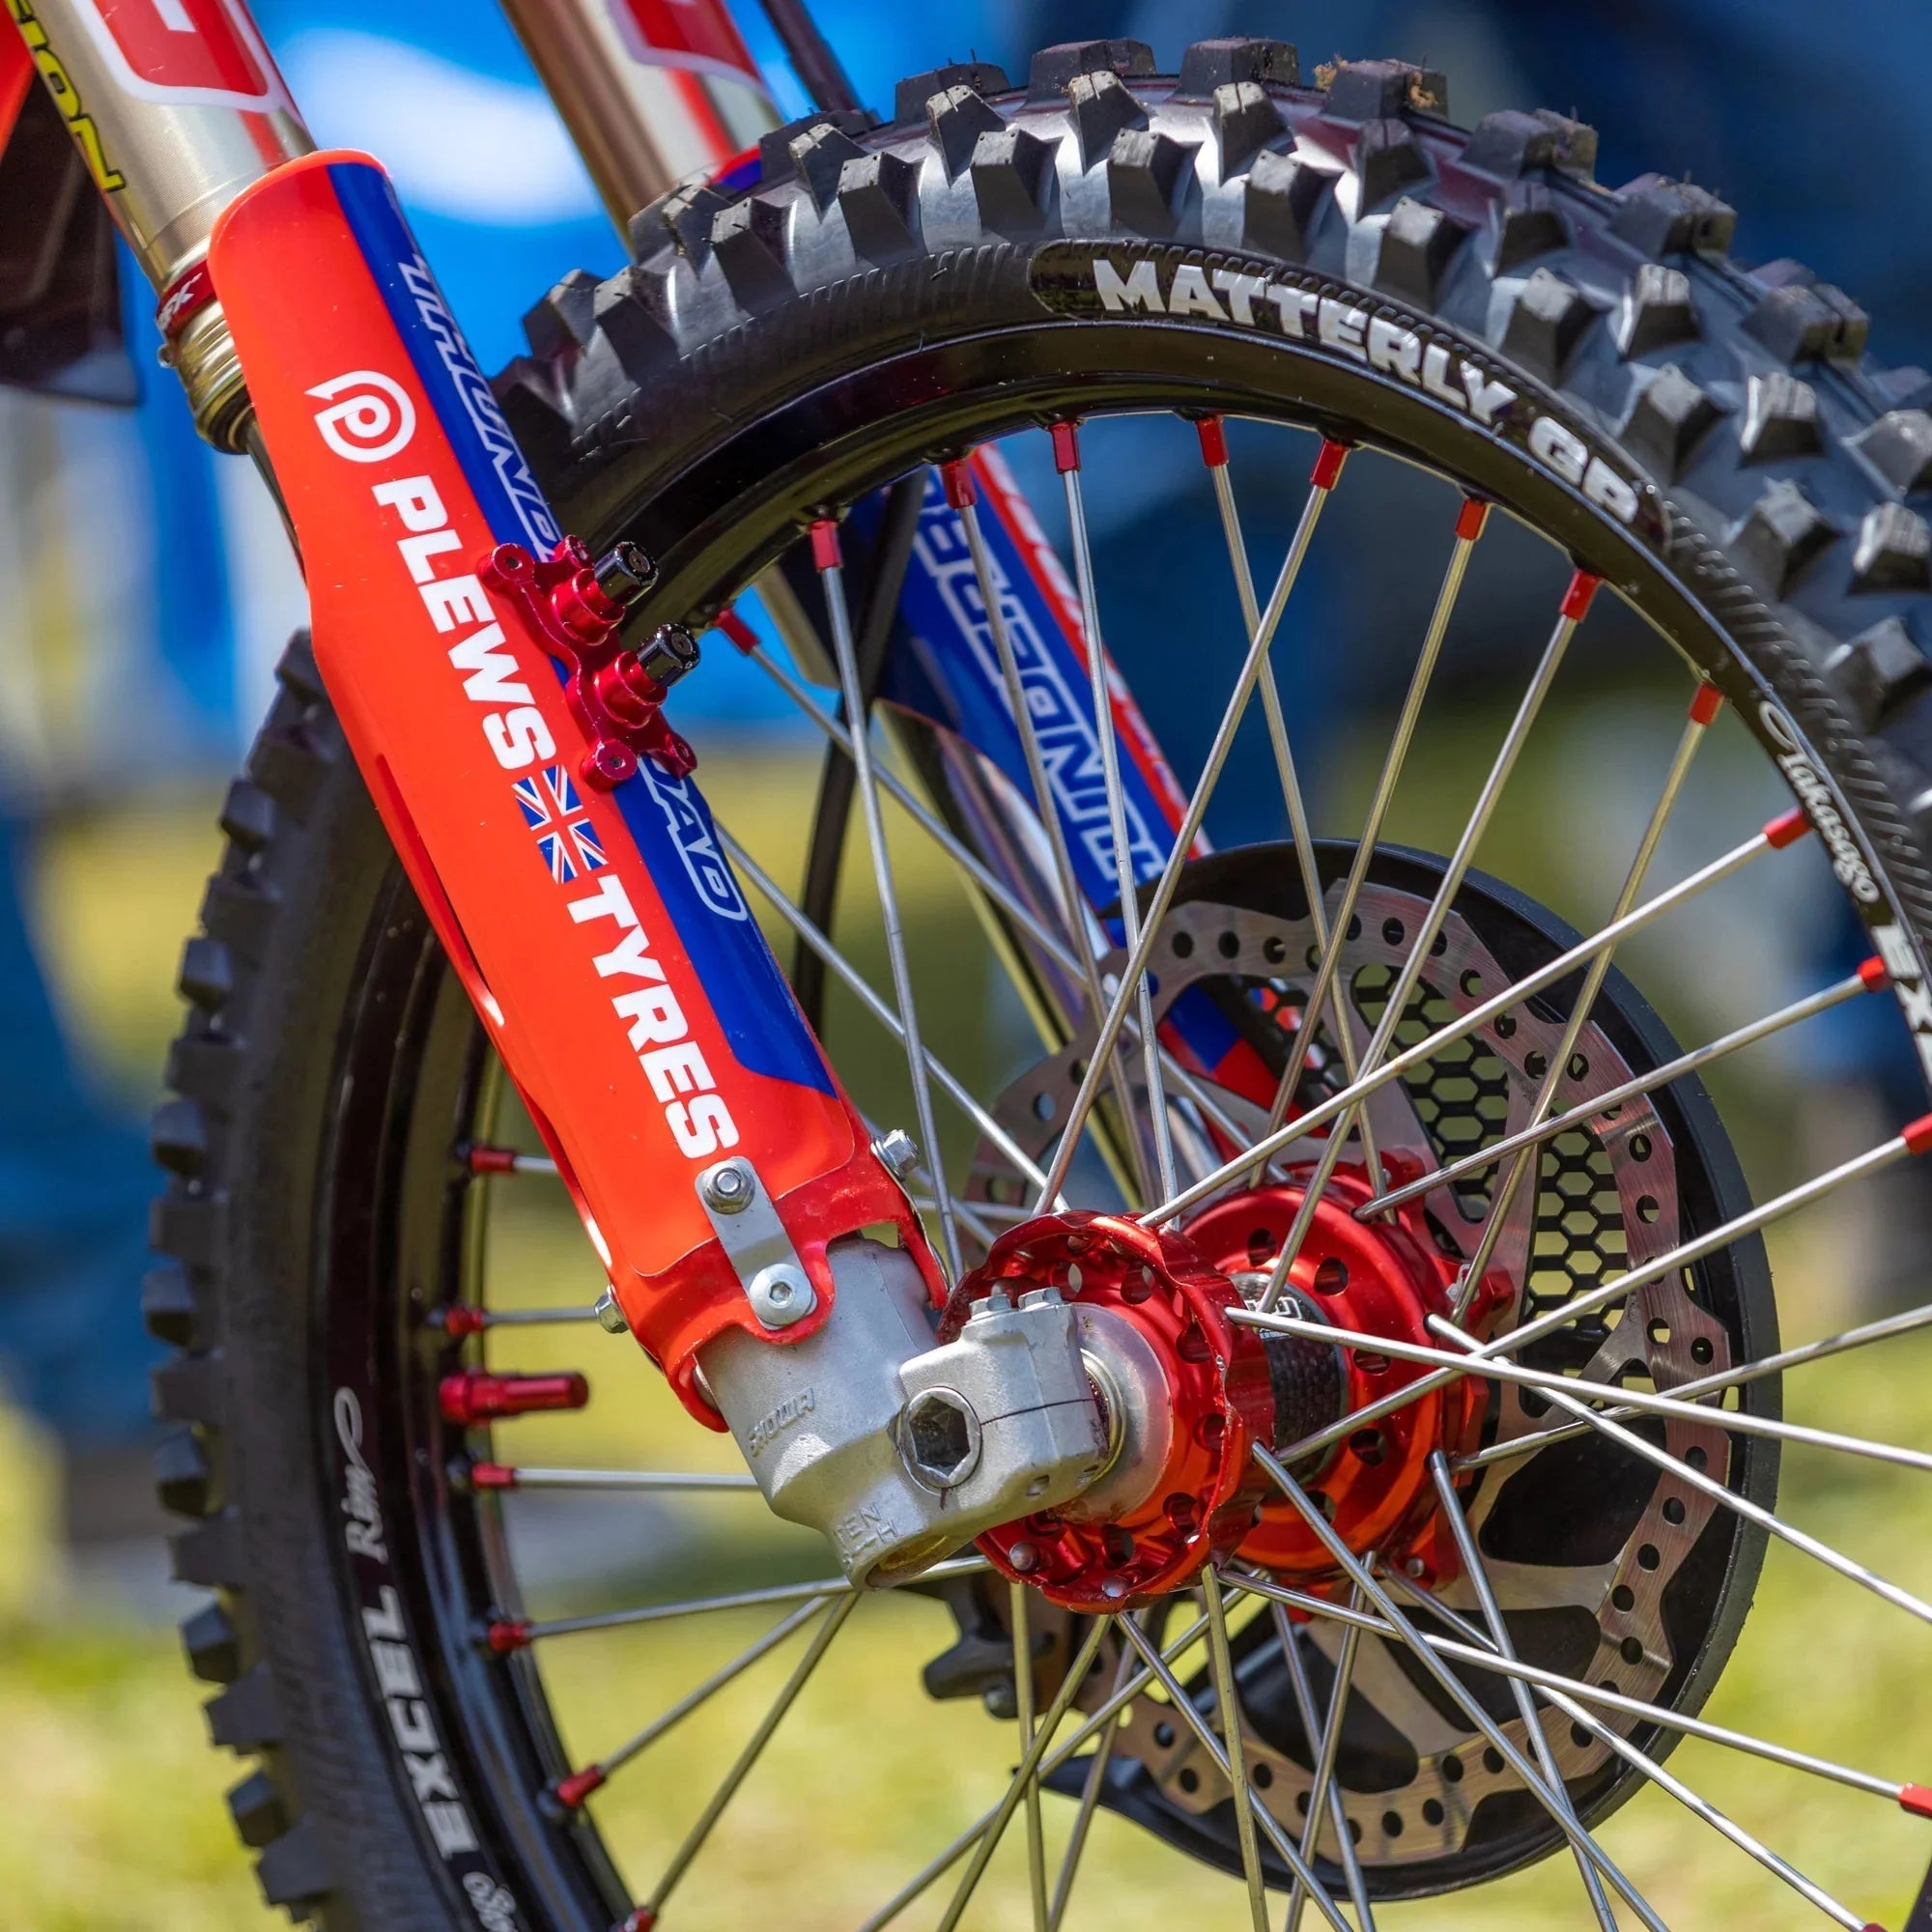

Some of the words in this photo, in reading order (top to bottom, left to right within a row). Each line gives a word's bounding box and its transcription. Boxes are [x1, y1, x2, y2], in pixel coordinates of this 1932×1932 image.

[1093, 258, 1518, 423] MATTERLY
[1528, 416, 1638, 524] GP
[371, 474, 557, 770] PLEWS
[567, 874, 740, 1158] TYRES
[1759, 700, 1880, 903] Takasago
[333, 1386, 388, 1565] Rim
[361, 1584, 479, 1861] EXCEL
